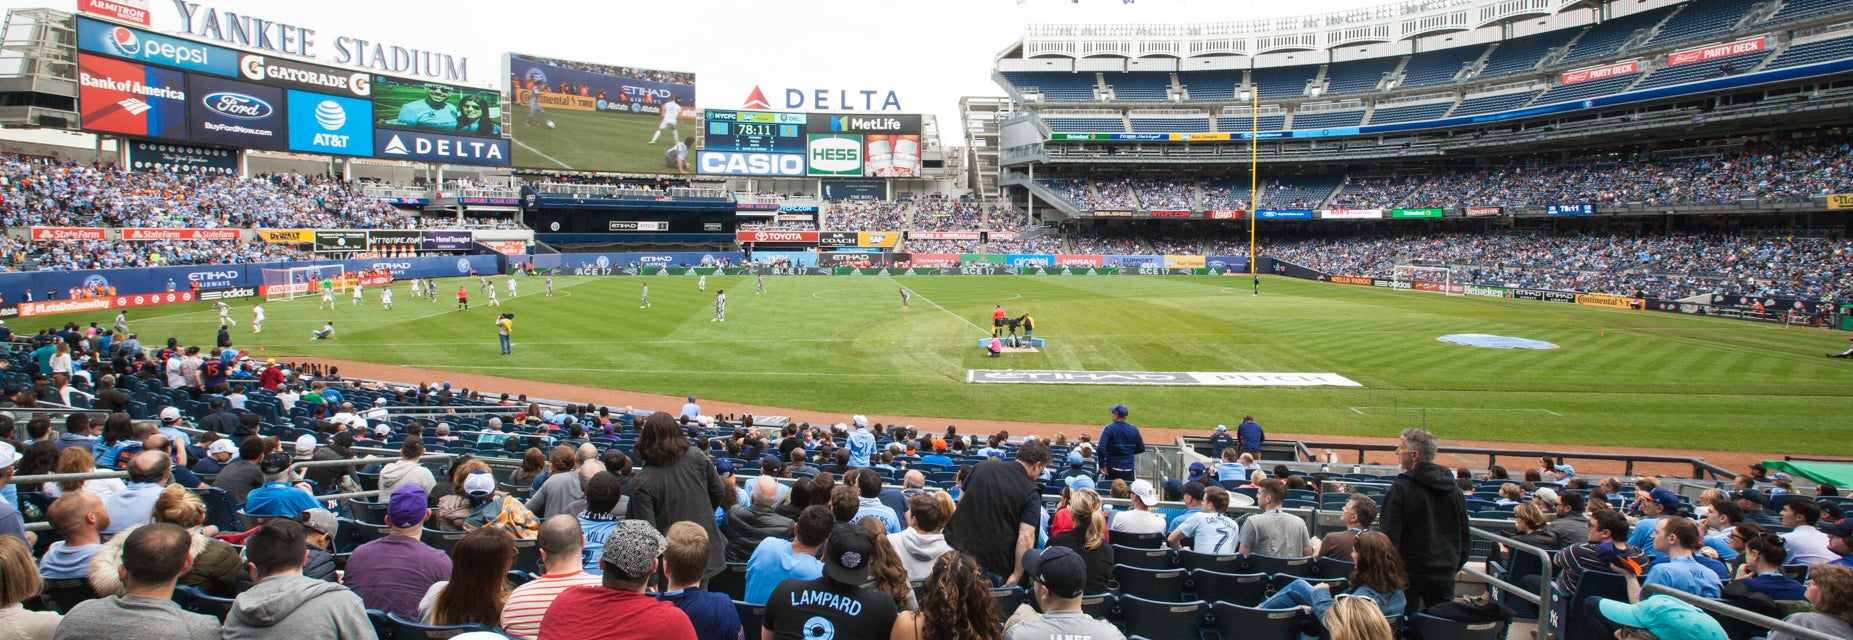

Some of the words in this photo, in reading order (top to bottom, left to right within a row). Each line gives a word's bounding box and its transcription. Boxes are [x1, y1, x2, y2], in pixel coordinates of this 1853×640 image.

[90, 0, 145, 18] ARMITRON
[176, 0, 316, 58] YANKEE
[334, 36, 468, 82] STADIUM
[144, 39, 208, 64] pepsi
[1704, 46, 1732, 60] PARTY
[1733, 40, 1758, 53] DECK
[266, 64, 348, 89] GATORADE
[1590, 67, 1611, 79] PARTY
[1612, 63, 1632, 75] DECK
[80, 72, 116, 90] Bank
[117, 80, 132, 92] of
[132, 82, 184, 101] America
[622, 86, 672, 98] ETIHAD
[216, 95, 260, 116] Ford
[578, 100, 594, 108] TIRE
[786, 88, 902, 110] DELTA
[714, 112, 736, 120] NYCFC
[204, 121, 272, 136] BuyFordNow.com
[738, 124, 770, 135] 78:11
[852, 118, 900, 130] MetLife
[784, 126, 792, 136] 2
[313, 133, 350, 148] AT&T
[416, 138, 502, 160] DELTA
[813, 148, 857, 160] HESS
[702, 153, 804, 174] CASIO
[869, 235, 884, 244] SAP
[188, 271, 238, 280] ETIHAD
[575, 268, 598, 276] ACE
[603, 268, 612, 276] 17
[1388, 280, 1410, 289] adidas
[222, 288, 254, 298] adidas
[1465, 285, 1503, 298] Heineken
[36, 300, 109, 313] #LetsDoGameDay
[1578, 294, 1618, 306] Continental
[207, 364, 219, 376] 15
[858, 442, 868, 454] 21
[95, 448, 106, 462] 7
[587, 531, 604, 544] VILL
[1213, 528, 1229, 555] 7
[791, 590, 862, 616] LAMPARD
